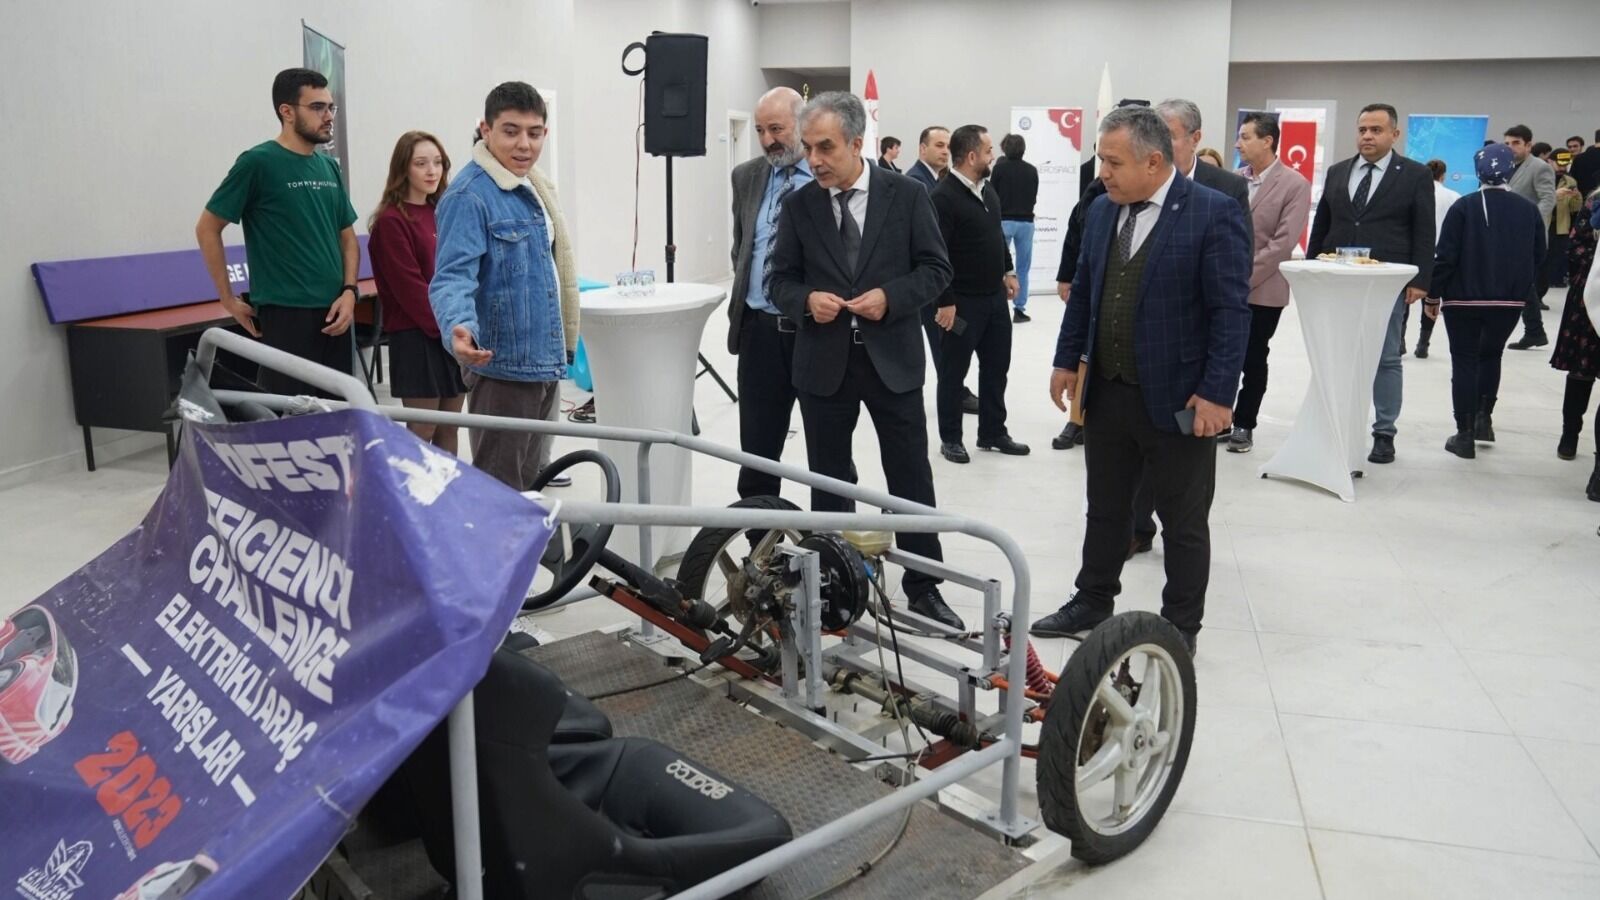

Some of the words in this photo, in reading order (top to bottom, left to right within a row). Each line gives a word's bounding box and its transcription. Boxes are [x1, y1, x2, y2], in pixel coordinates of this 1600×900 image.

[189, 534, 351, 704] CHALLENGE
[146, 664, 246, 787] YARIŞLARI
[252, 686, 318, 774] ARAÇ
[73, 730, 182, 849] 2023
